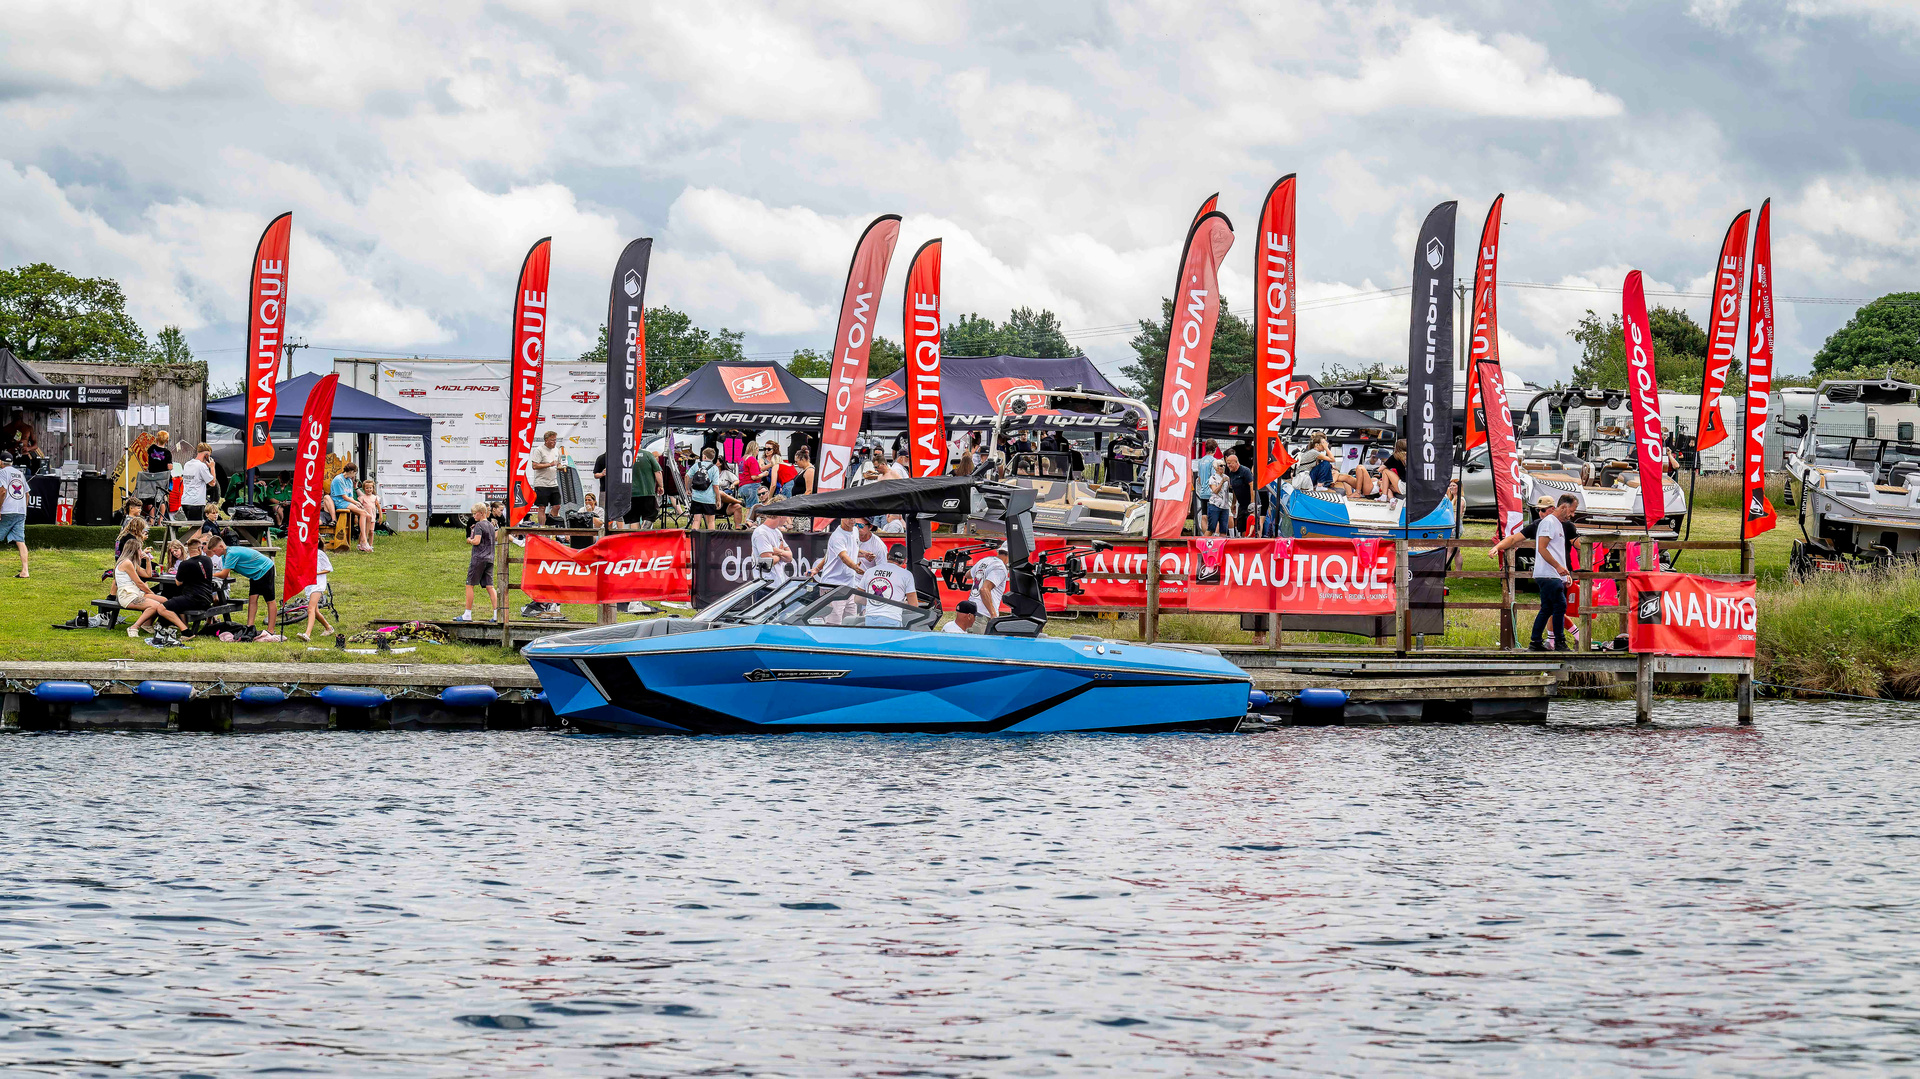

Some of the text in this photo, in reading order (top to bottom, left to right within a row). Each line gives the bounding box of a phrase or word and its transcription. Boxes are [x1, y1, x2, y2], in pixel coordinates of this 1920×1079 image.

[255, 259, 282, 418] NAUTIQUE
[1267, 232, 1291, 432] NAUTIQUE
[1709, 256, 1738, 406] NAUTIQUE
[1763, 295, 1771, 319] RIDING
[55, 389, 70, 400] UK
[517, 289, 545, 475] NAUTIQUE
[621, 305, 638, 484] LIQUID FORCE
[711, 413, 822, 426] NAUTIQUE
[915, 293, 941, 478] NAUTIQUE
[1422, 279, 1439, 481] LIQUID FORCE
[1627, 322, 1662, 462] dryrobe
[297, 420, 323, 542] dryrobe
[408, 513, 419, 530] 3
[537, 555, 674, 576] NAUTIQUE
[1223, 553, 1389, 591] NAUTIQUE
[1319, 592, 1343, 600] SURFING
